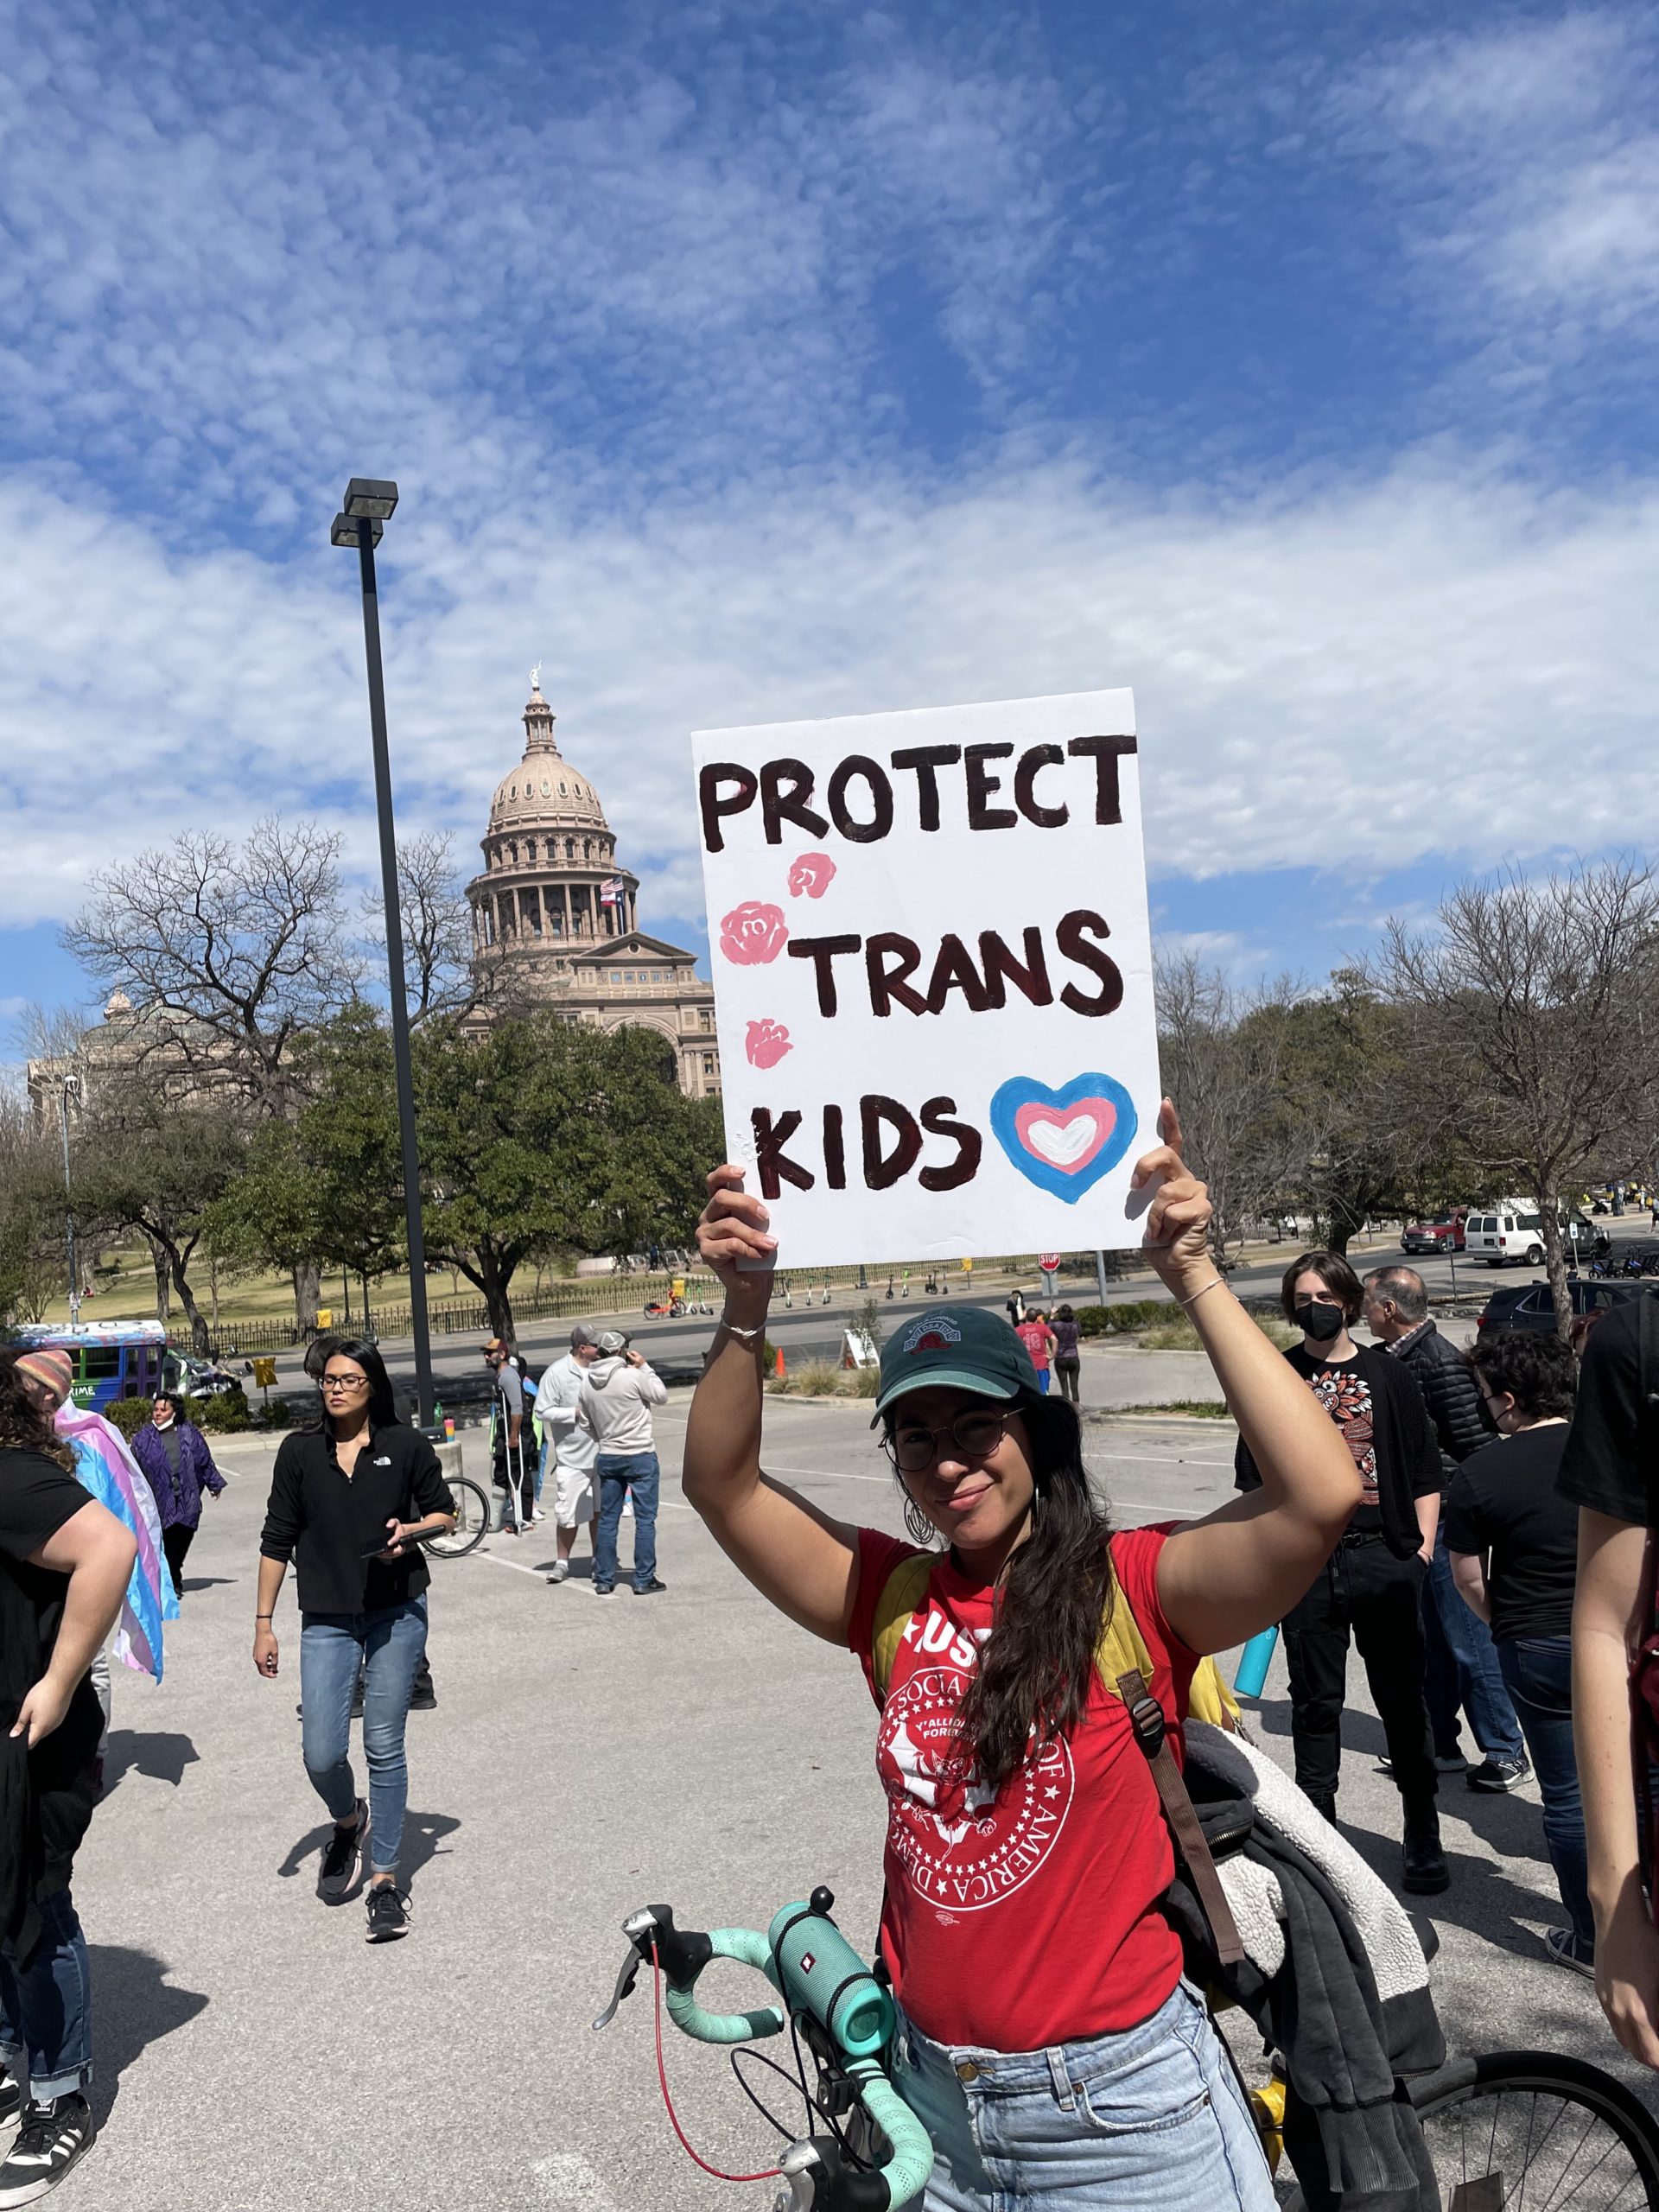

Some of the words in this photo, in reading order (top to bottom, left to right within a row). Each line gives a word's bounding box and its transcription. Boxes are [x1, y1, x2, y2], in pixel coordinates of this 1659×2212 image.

[699, 734, 1137, 853] PROTECT
[787, 909, 1123, 1017] TRANS
[750, 1094, 982, 1199] KIDS
[1039, 1254, 1058, 1264] STOP
[952, 1803, 1058, 1903] AMERICA
